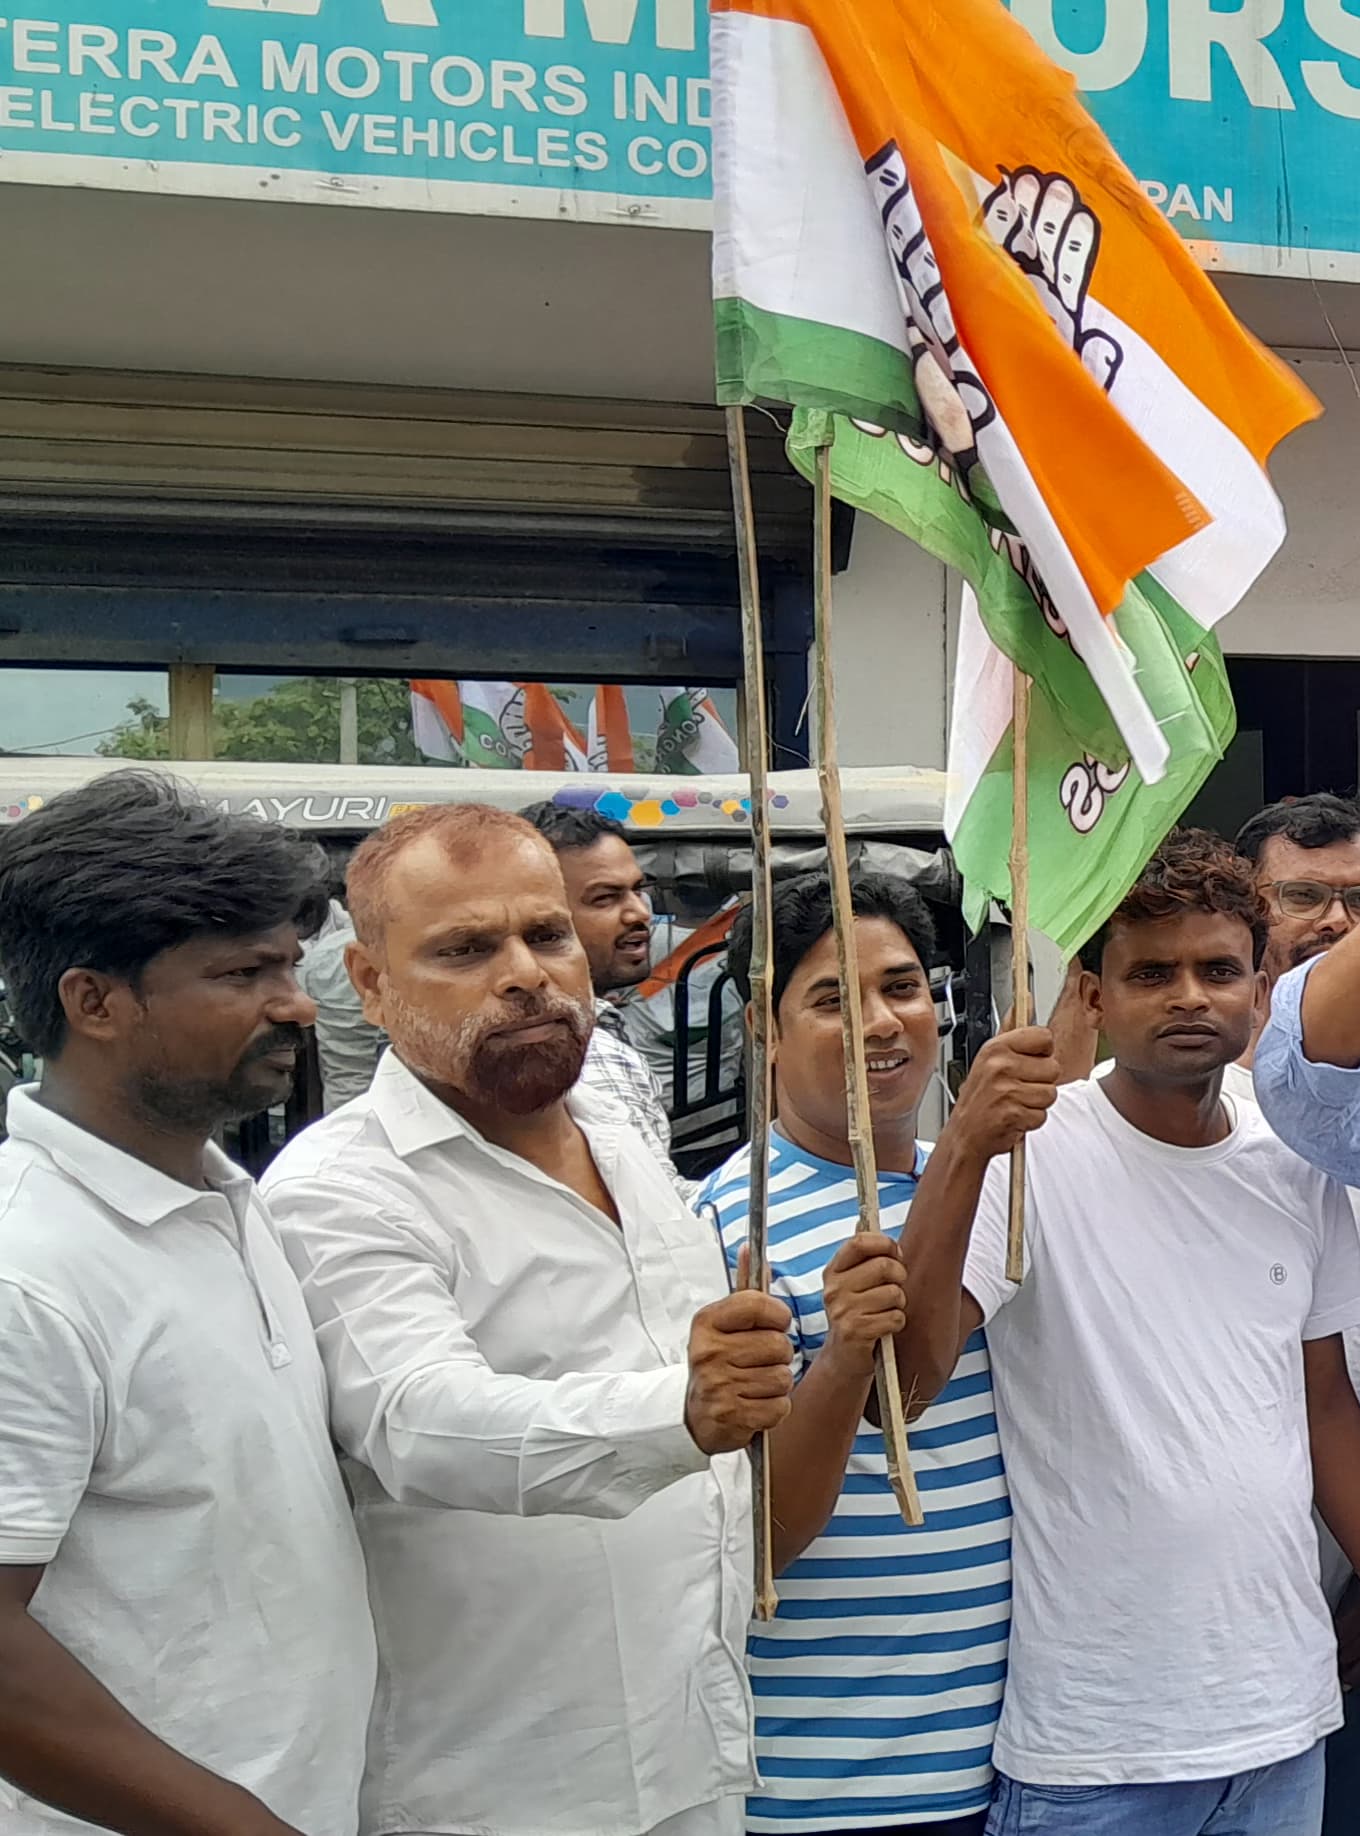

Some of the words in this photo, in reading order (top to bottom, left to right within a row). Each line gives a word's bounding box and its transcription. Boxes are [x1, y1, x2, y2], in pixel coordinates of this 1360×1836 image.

[0, 18, 239, 88] ERRA
[262, 40, 588, 117] MOTORS
[0, 86, 302, 147] ELECTRIC
[320, 110, 609, 172] VEHICLES
